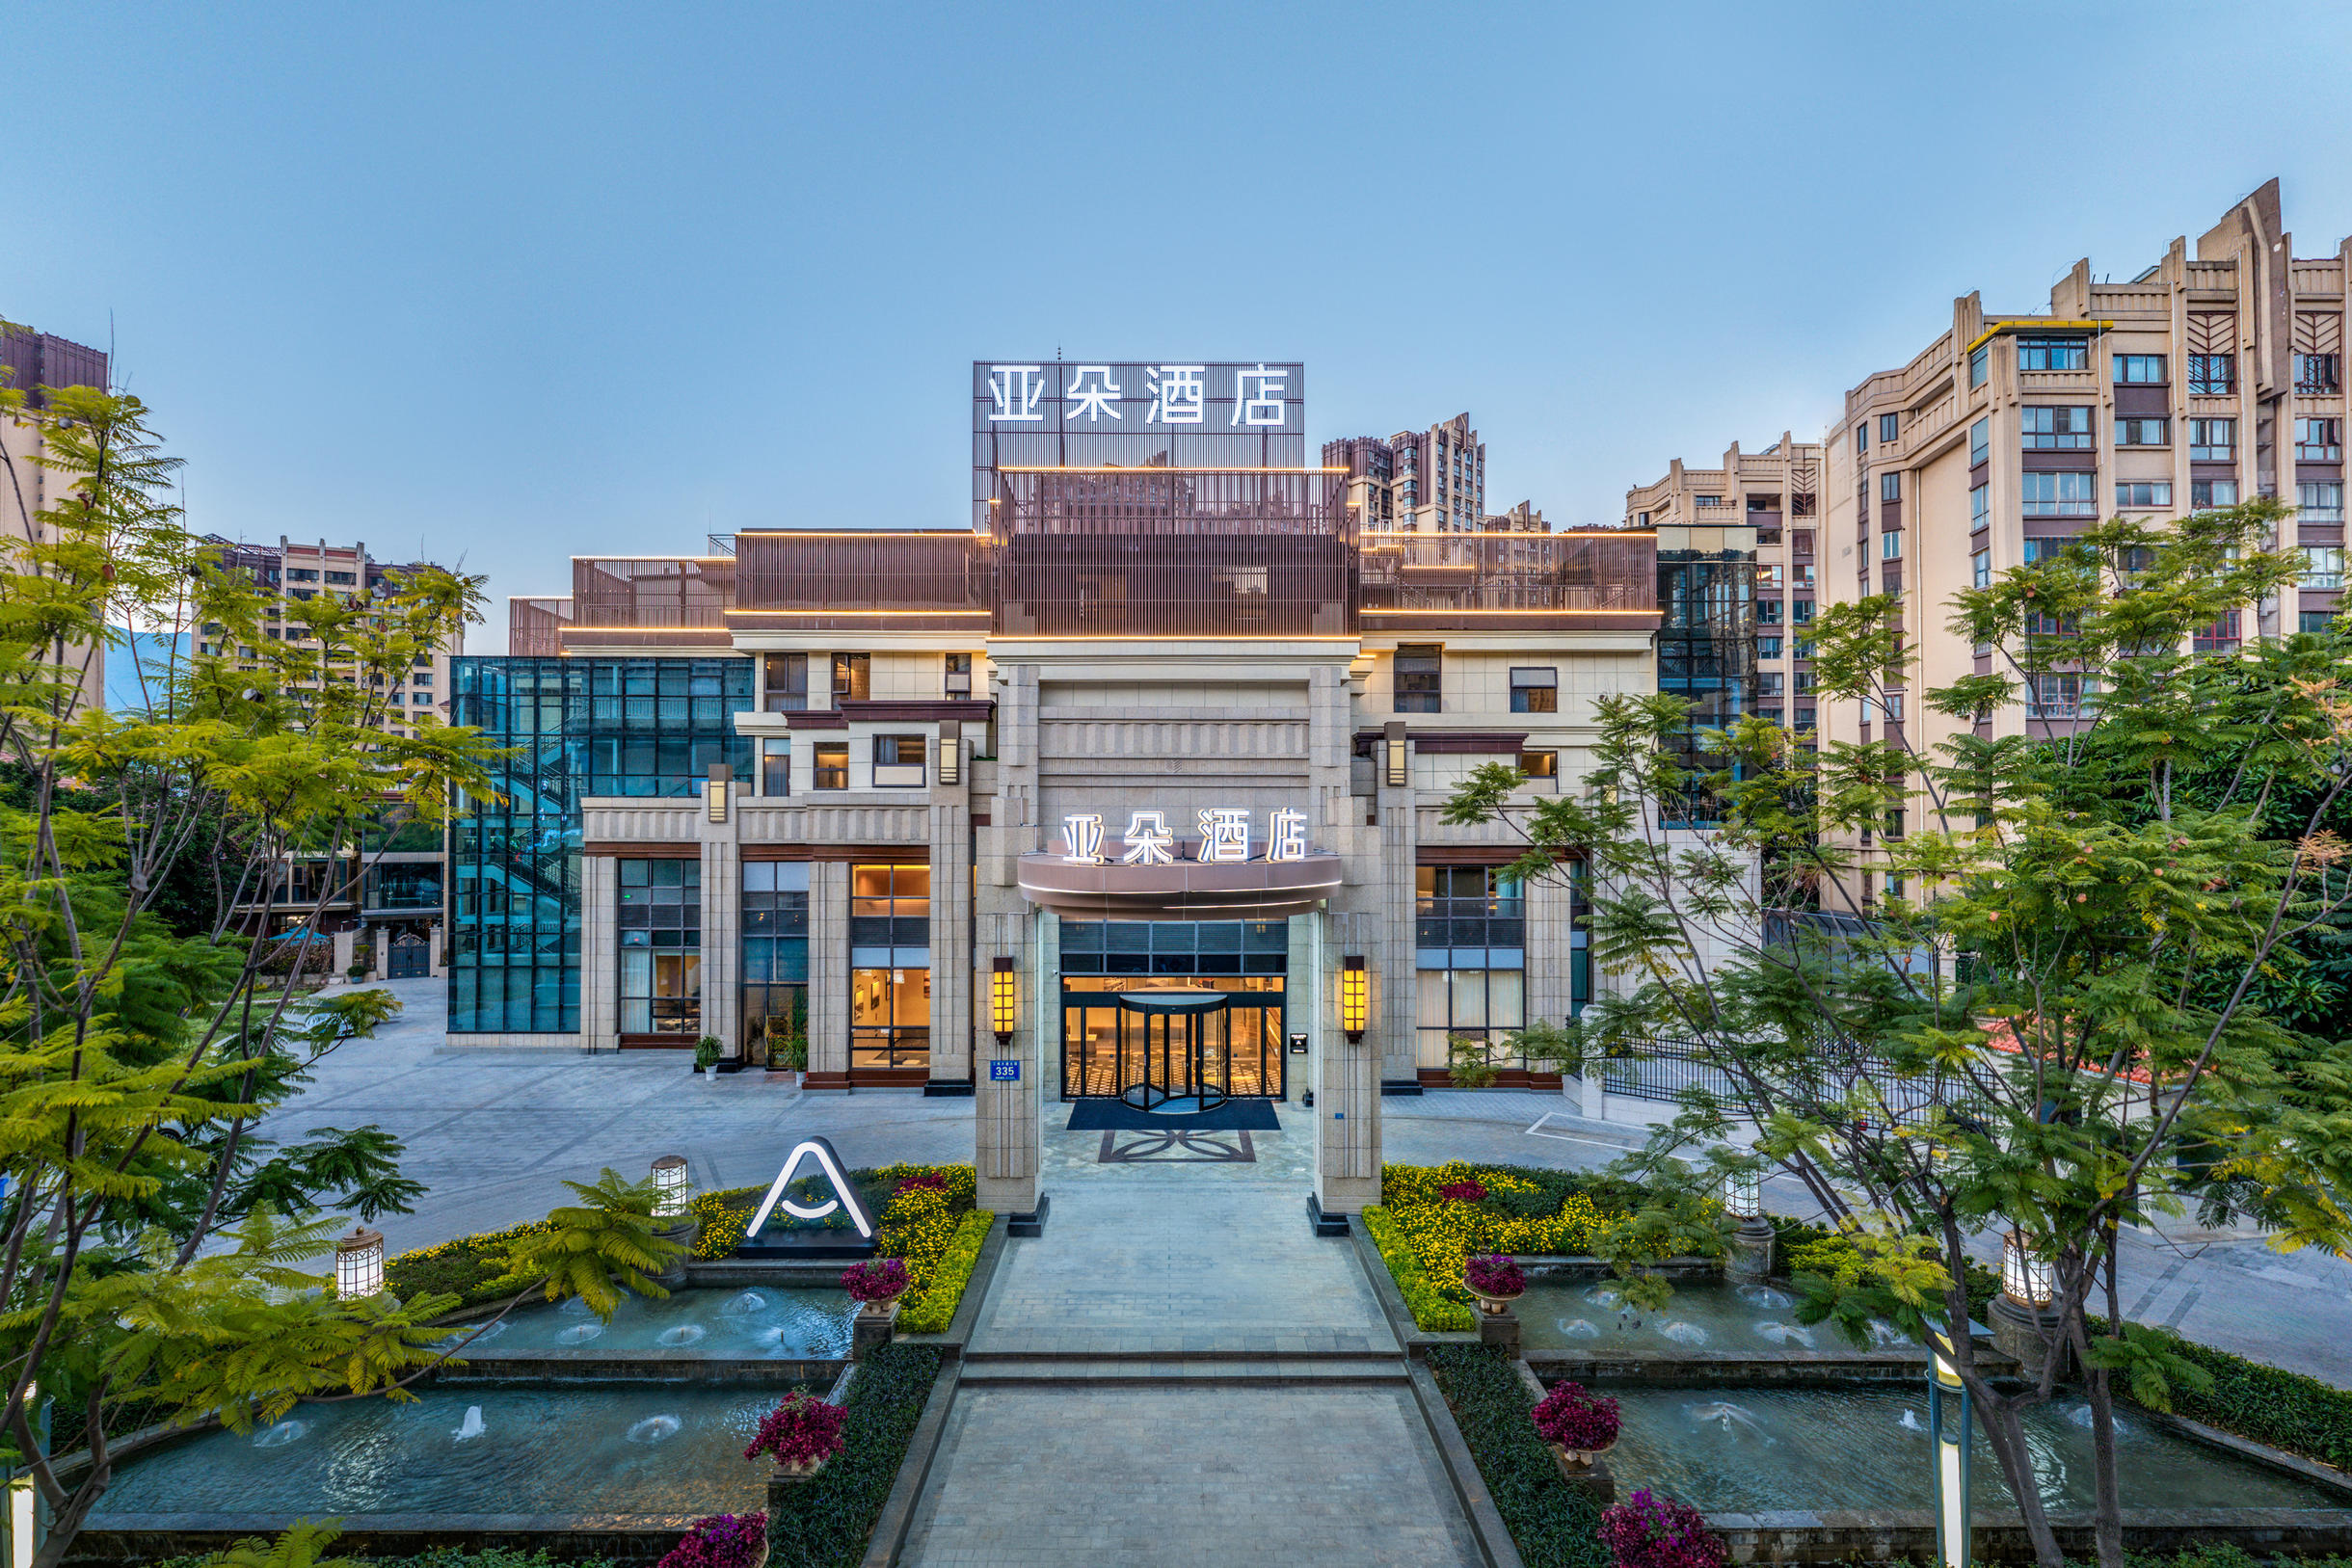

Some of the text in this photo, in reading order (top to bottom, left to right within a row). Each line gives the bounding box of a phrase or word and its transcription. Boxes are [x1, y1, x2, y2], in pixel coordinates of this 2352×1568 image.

[988, 363, 1289, 427] 亚朵酒店
[1062, 808, 1308, 864] 亚朵酒店
[996, 1066, 1015, 1076] 335
